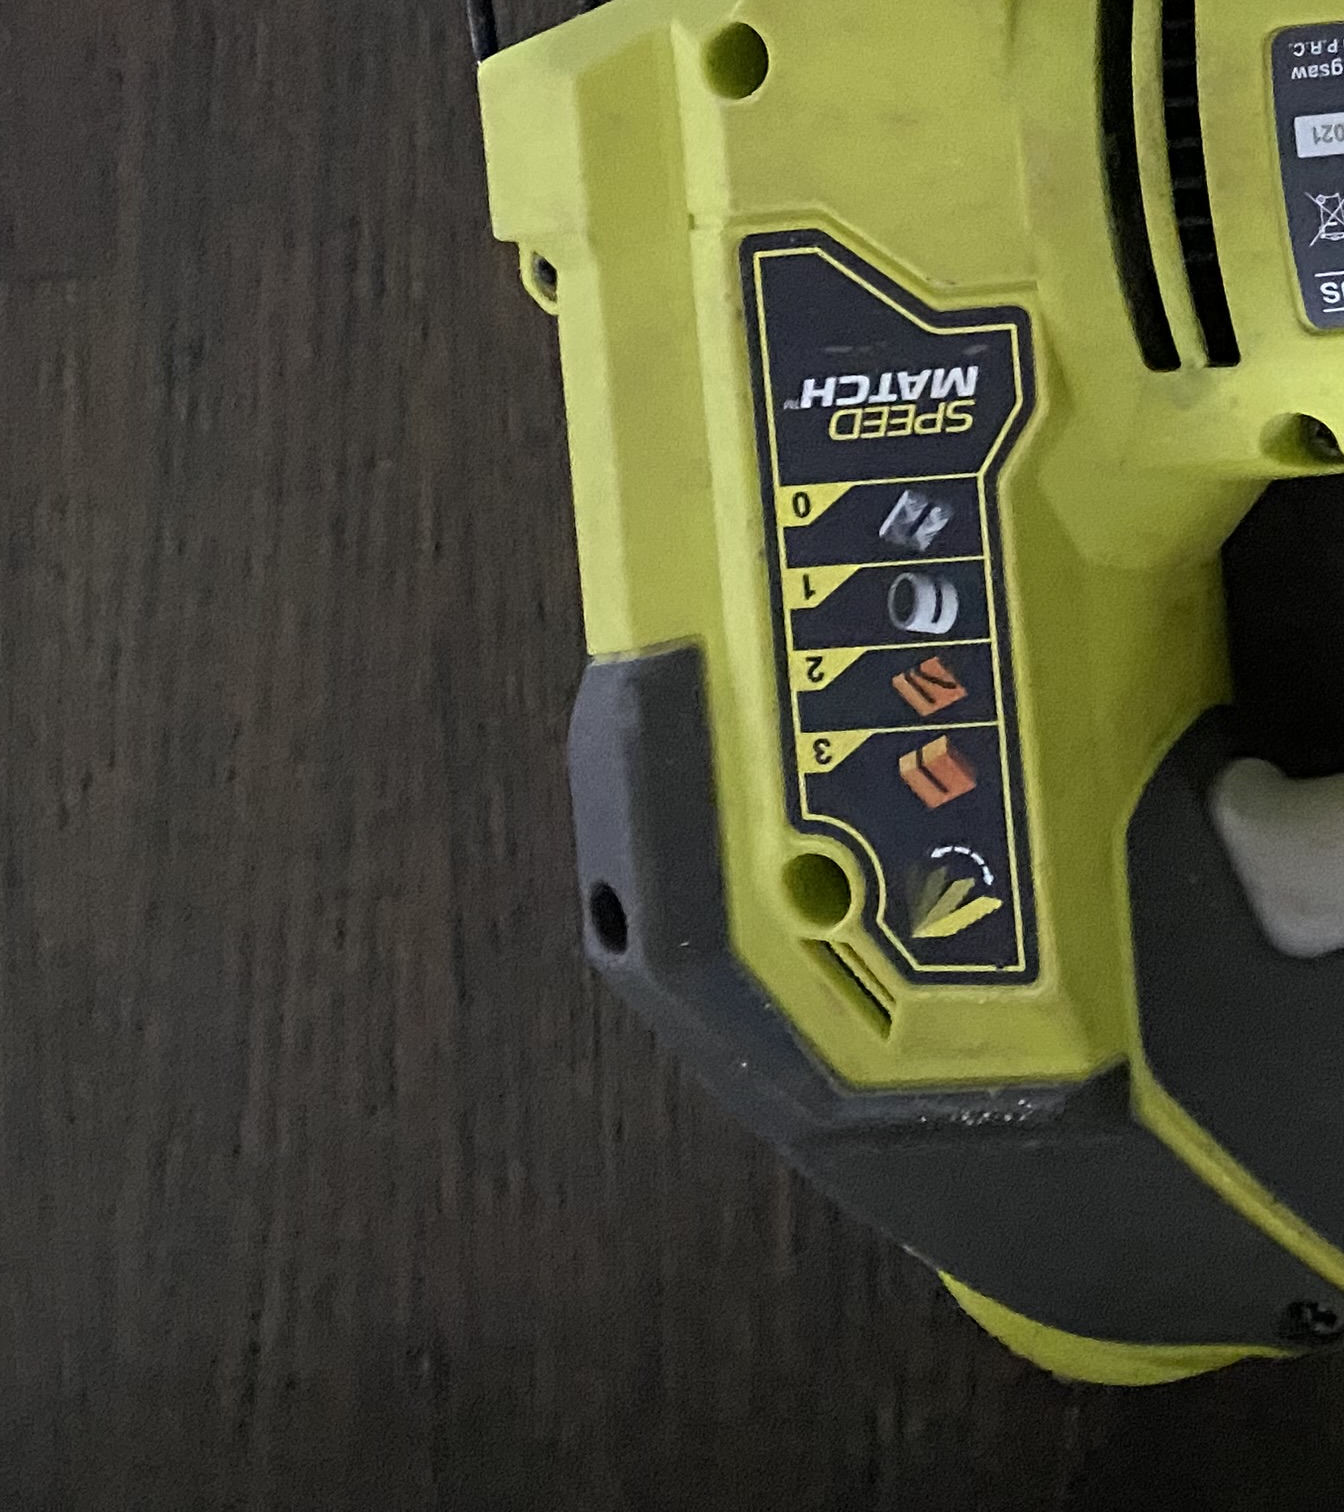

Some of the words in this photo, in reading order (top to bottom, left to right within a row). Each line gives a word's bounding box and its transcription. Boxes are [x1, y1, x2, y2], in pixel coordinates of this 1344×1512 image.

[1289, 37, 1339, 57] P.R.C.
[829, 399, 976, 441] SPEED
[792, 491, 811, 518] 0
[802, 574, 816, 600] 1
[805, 656, 824, 683] 2
[812, 738, 832, 765] 3
